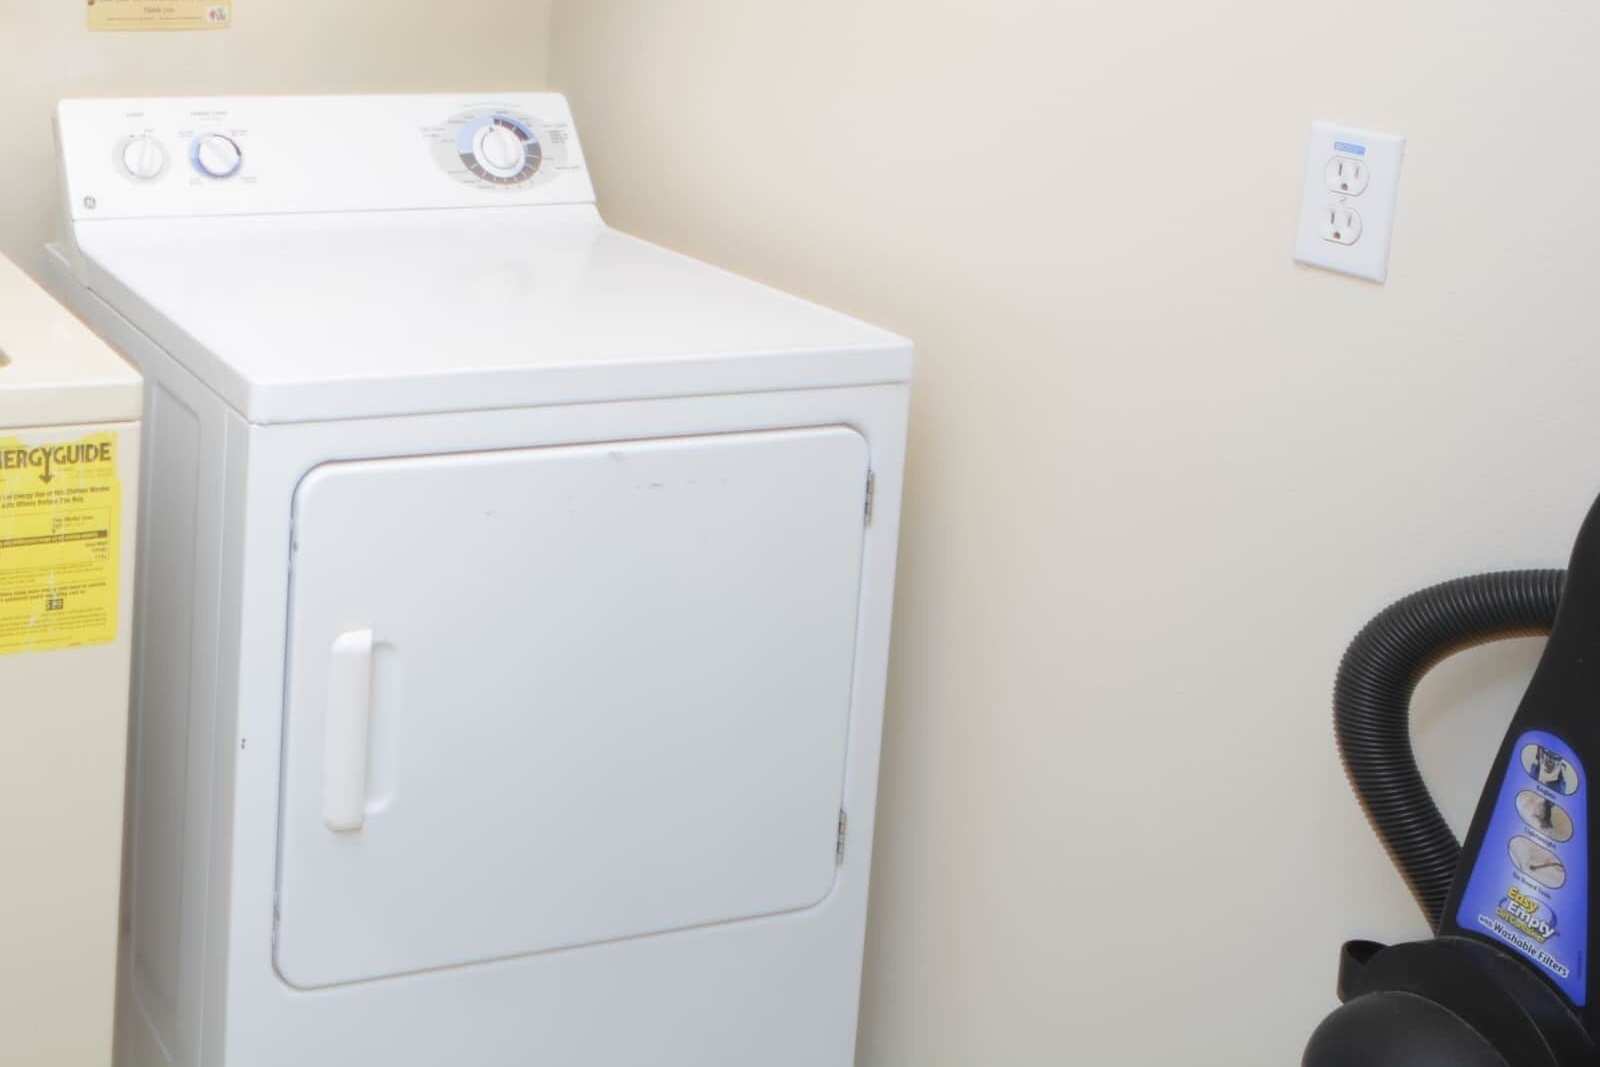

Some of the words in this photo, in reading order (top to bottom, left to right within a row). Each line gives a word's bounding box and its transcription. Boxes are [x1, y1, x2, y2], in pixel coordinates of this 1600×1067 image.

[1507, 886, 1538, 913] Easy
[1507, 899, 1555, 938] Empty
[1493, 920, 1537, 957] Washable
[1536, 950, 1567, 976] Filters
